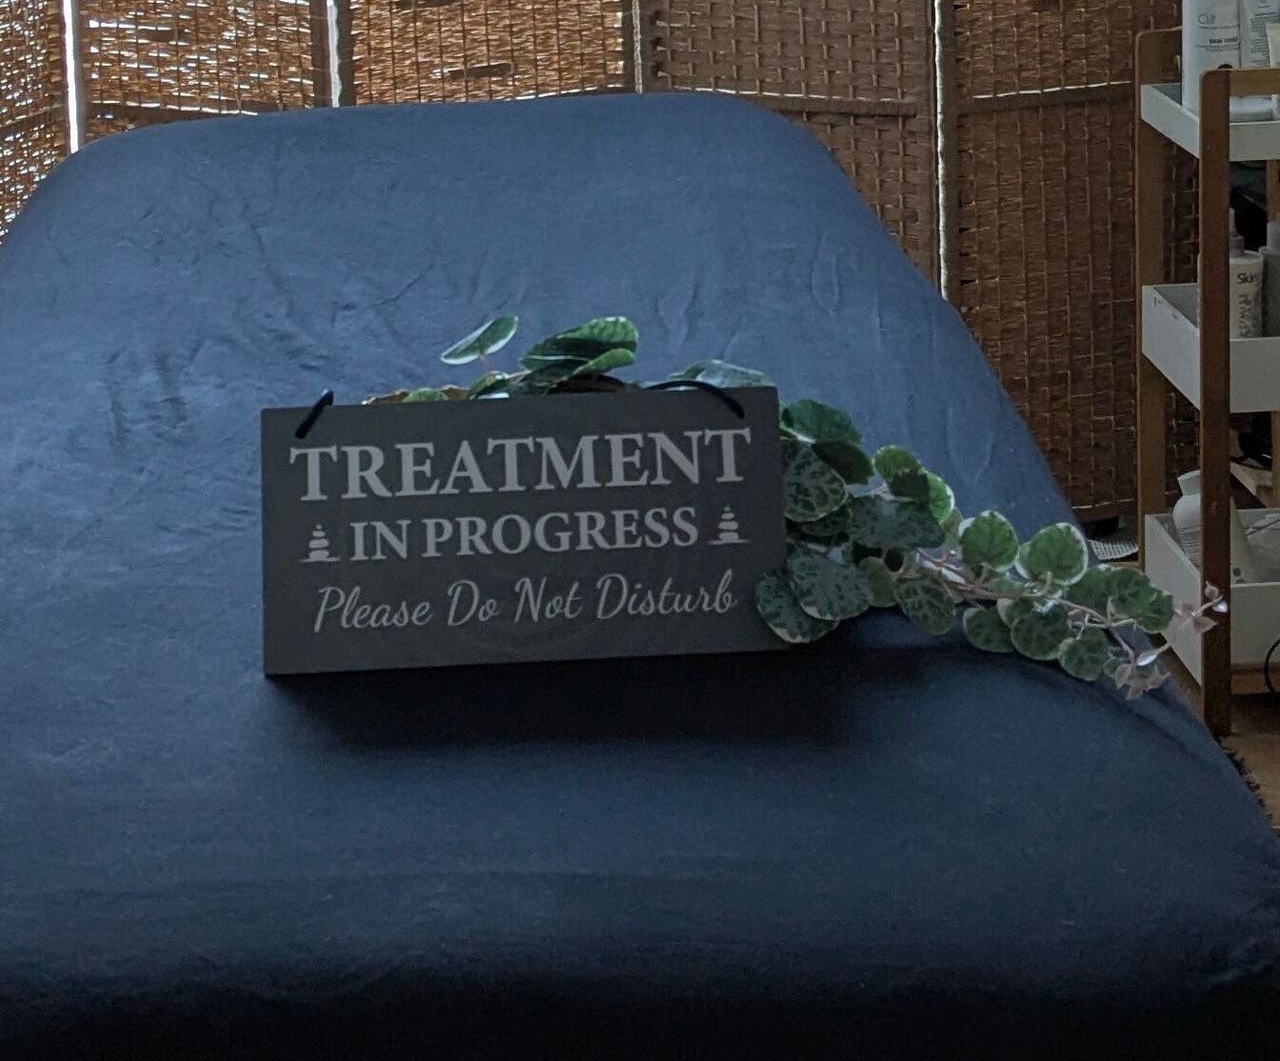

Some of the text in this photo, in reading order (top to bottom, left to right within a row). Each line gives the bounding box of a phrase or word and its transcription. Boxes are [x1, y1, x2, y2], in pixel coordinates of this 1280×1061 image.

[290, 427, 751, 501] TREATMENT
[350, 507, 698, 561] IN PROGRESS
[314, 569, 737, 633] Please Do Not Disturb
